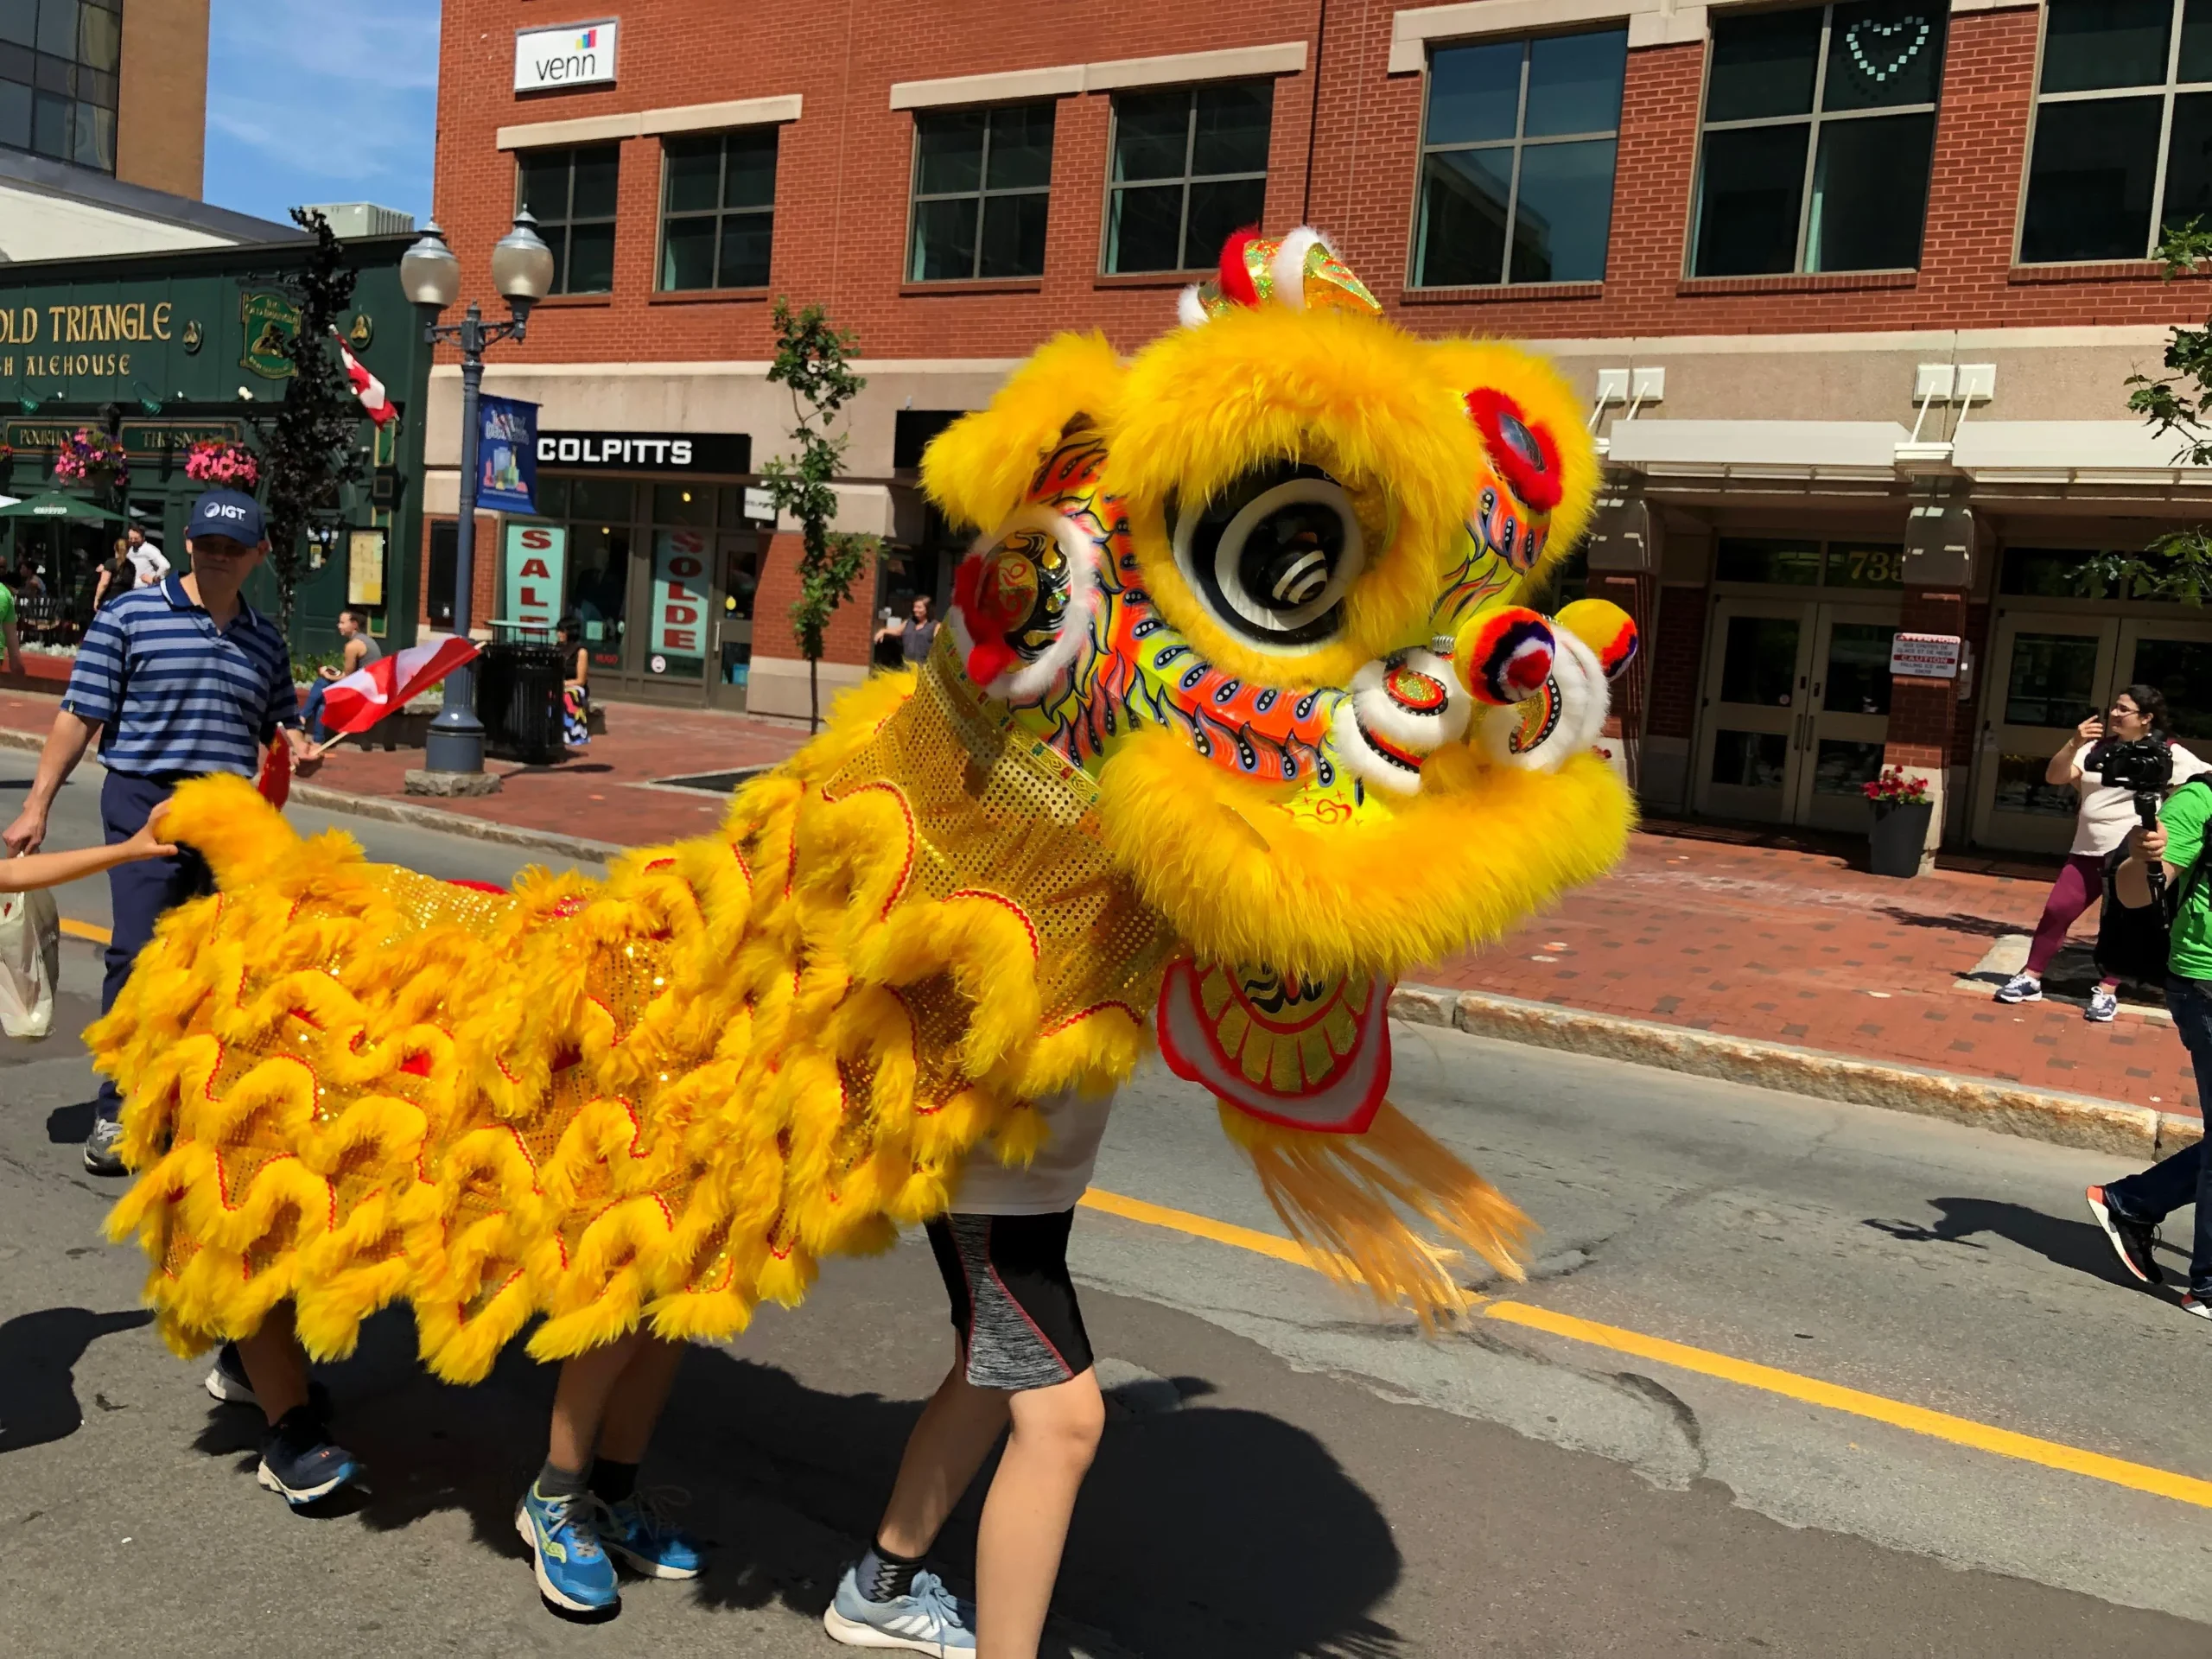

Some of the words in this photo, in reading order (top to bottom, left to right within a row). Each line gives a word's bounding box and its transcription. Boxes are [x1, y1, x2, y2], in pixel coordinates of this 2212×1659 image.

[536, 54, 595, 80] venn
[48, 302, 172, 342] TRIANGLE
[26, 354, 130, 376] ALEHOUSE
[537, 438, 692, 465] COLPITTS
[220, 504, 246, 520] IGT
[519, 529, 552, 635] SALE
[664, 531, 704, 651] SOLDE
[1901, 655, 1948, 664] CAUTION
